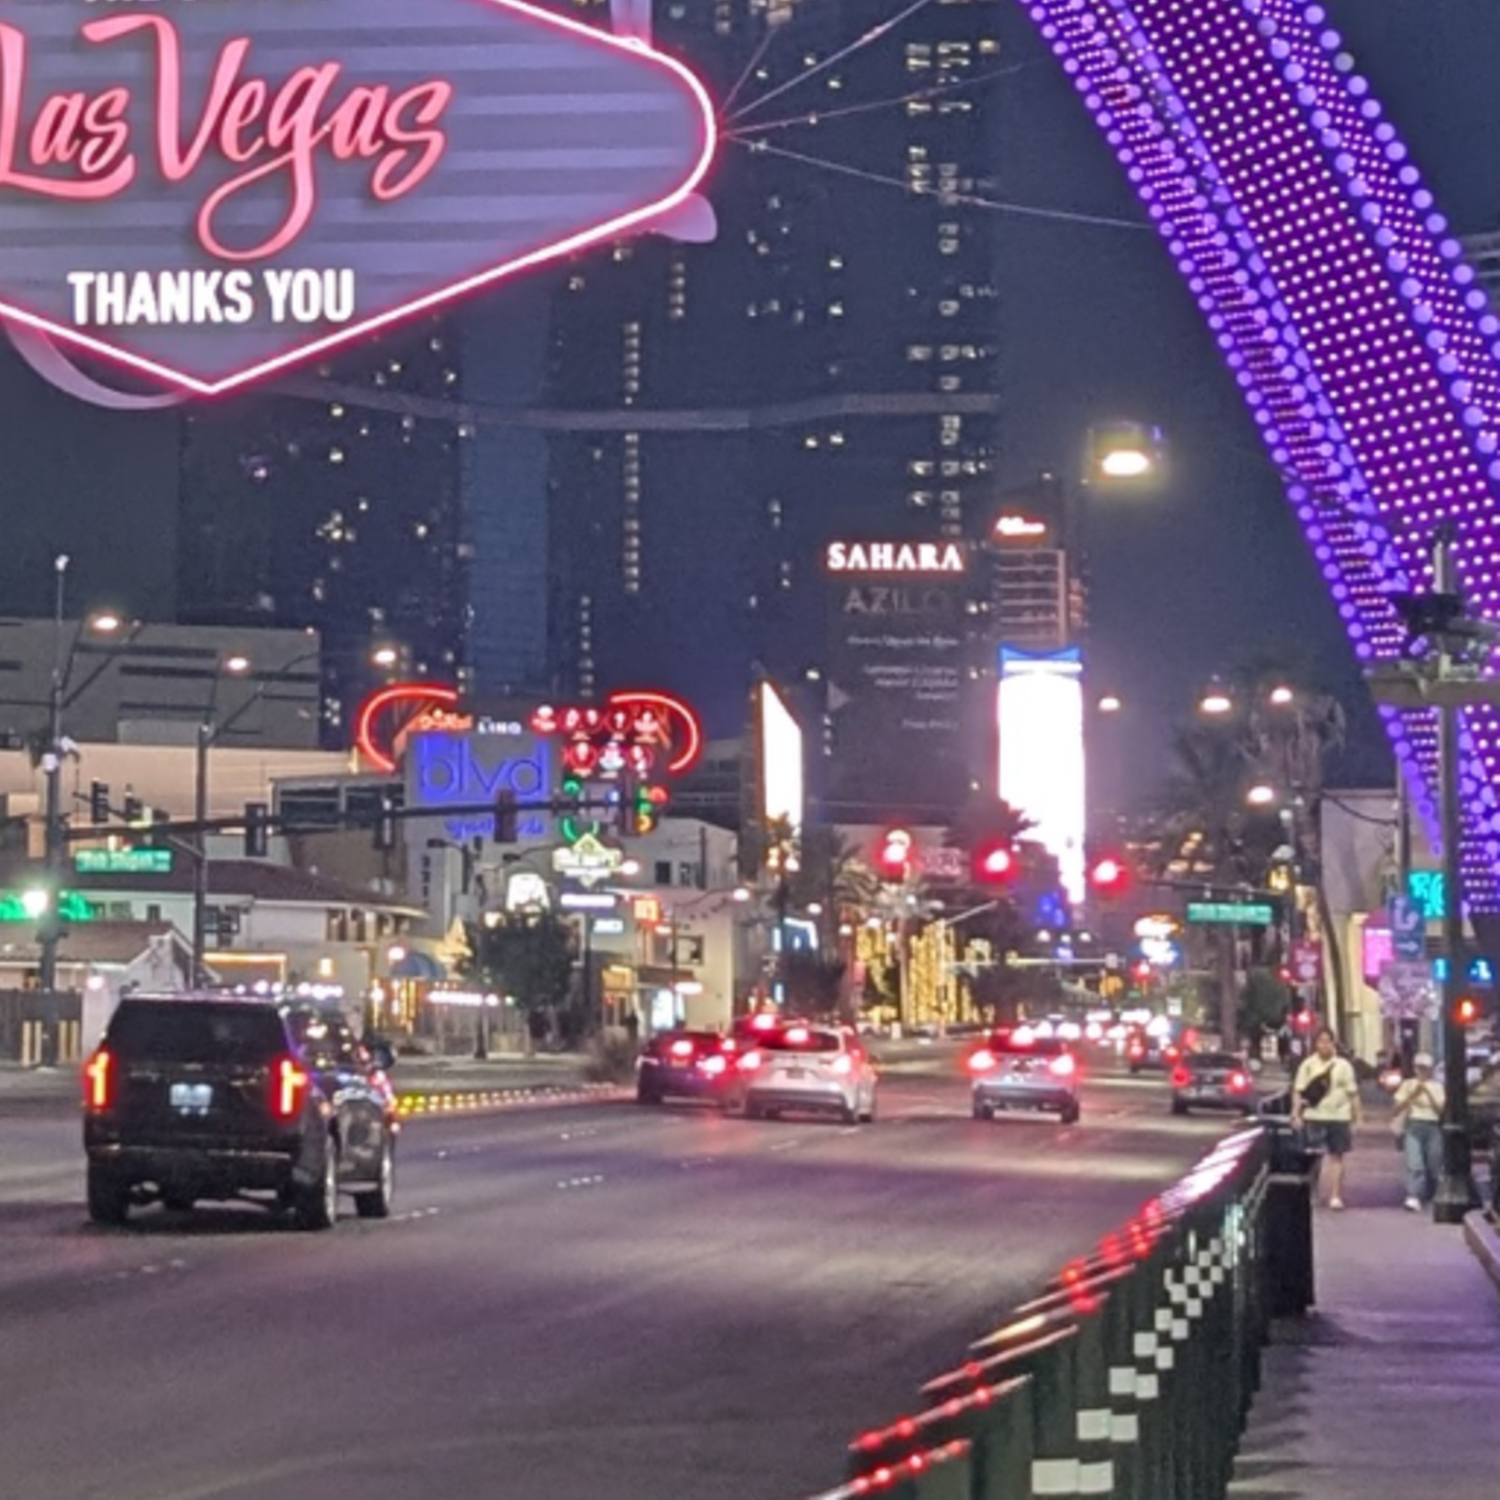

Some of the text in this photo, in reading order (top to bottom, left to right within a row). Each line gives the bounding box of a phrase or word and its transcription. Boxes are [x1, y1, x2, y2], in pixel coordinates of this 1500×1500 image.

[82, 14, 452, 261] Vegas
[66, 268, 355, 325] THANKS YOU
[827, 541, 964, 571] SAHARA
[418, 735, 548, 798] blvd
